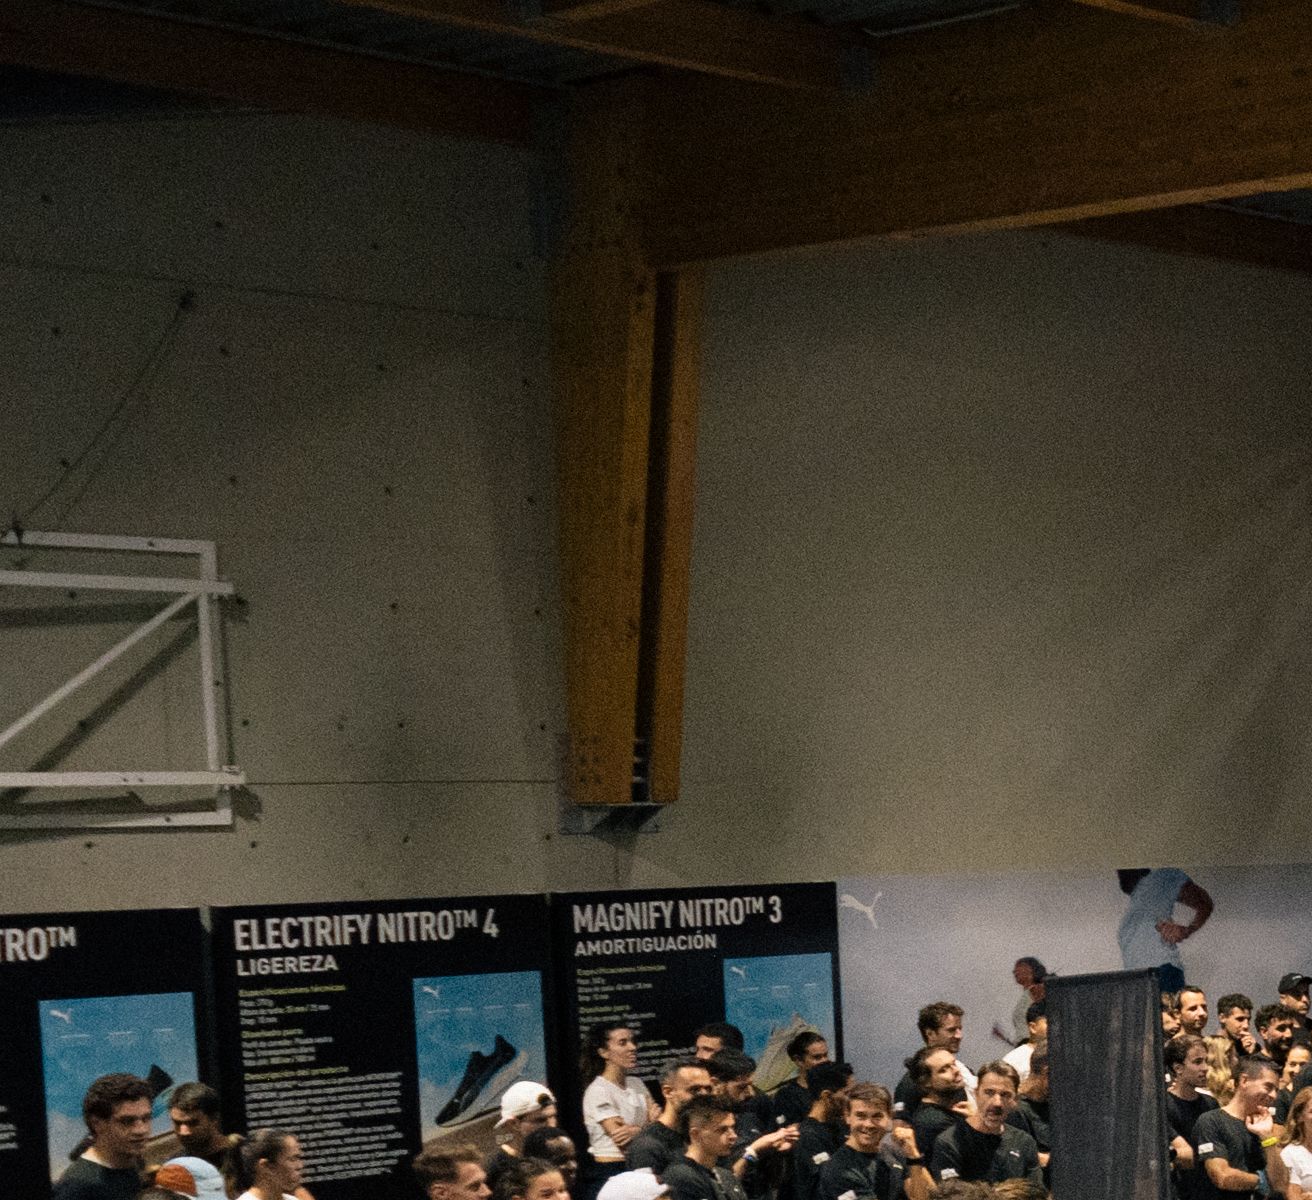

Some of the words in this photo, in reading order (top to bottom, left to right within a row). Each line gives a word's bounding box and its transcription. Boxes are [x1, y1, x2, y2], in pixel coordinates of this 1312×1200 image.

[233, 913, 372, 952] ELECTRIFY
[482, 908, 499, 939] 4
[573, 899, 673, 935] MAGNIFY
[769, 895, 782, 924] 3
[574, 931, 717, 958] AMORTIGUACIÓN
[236, 954, 339, 977] LIGEREZA
